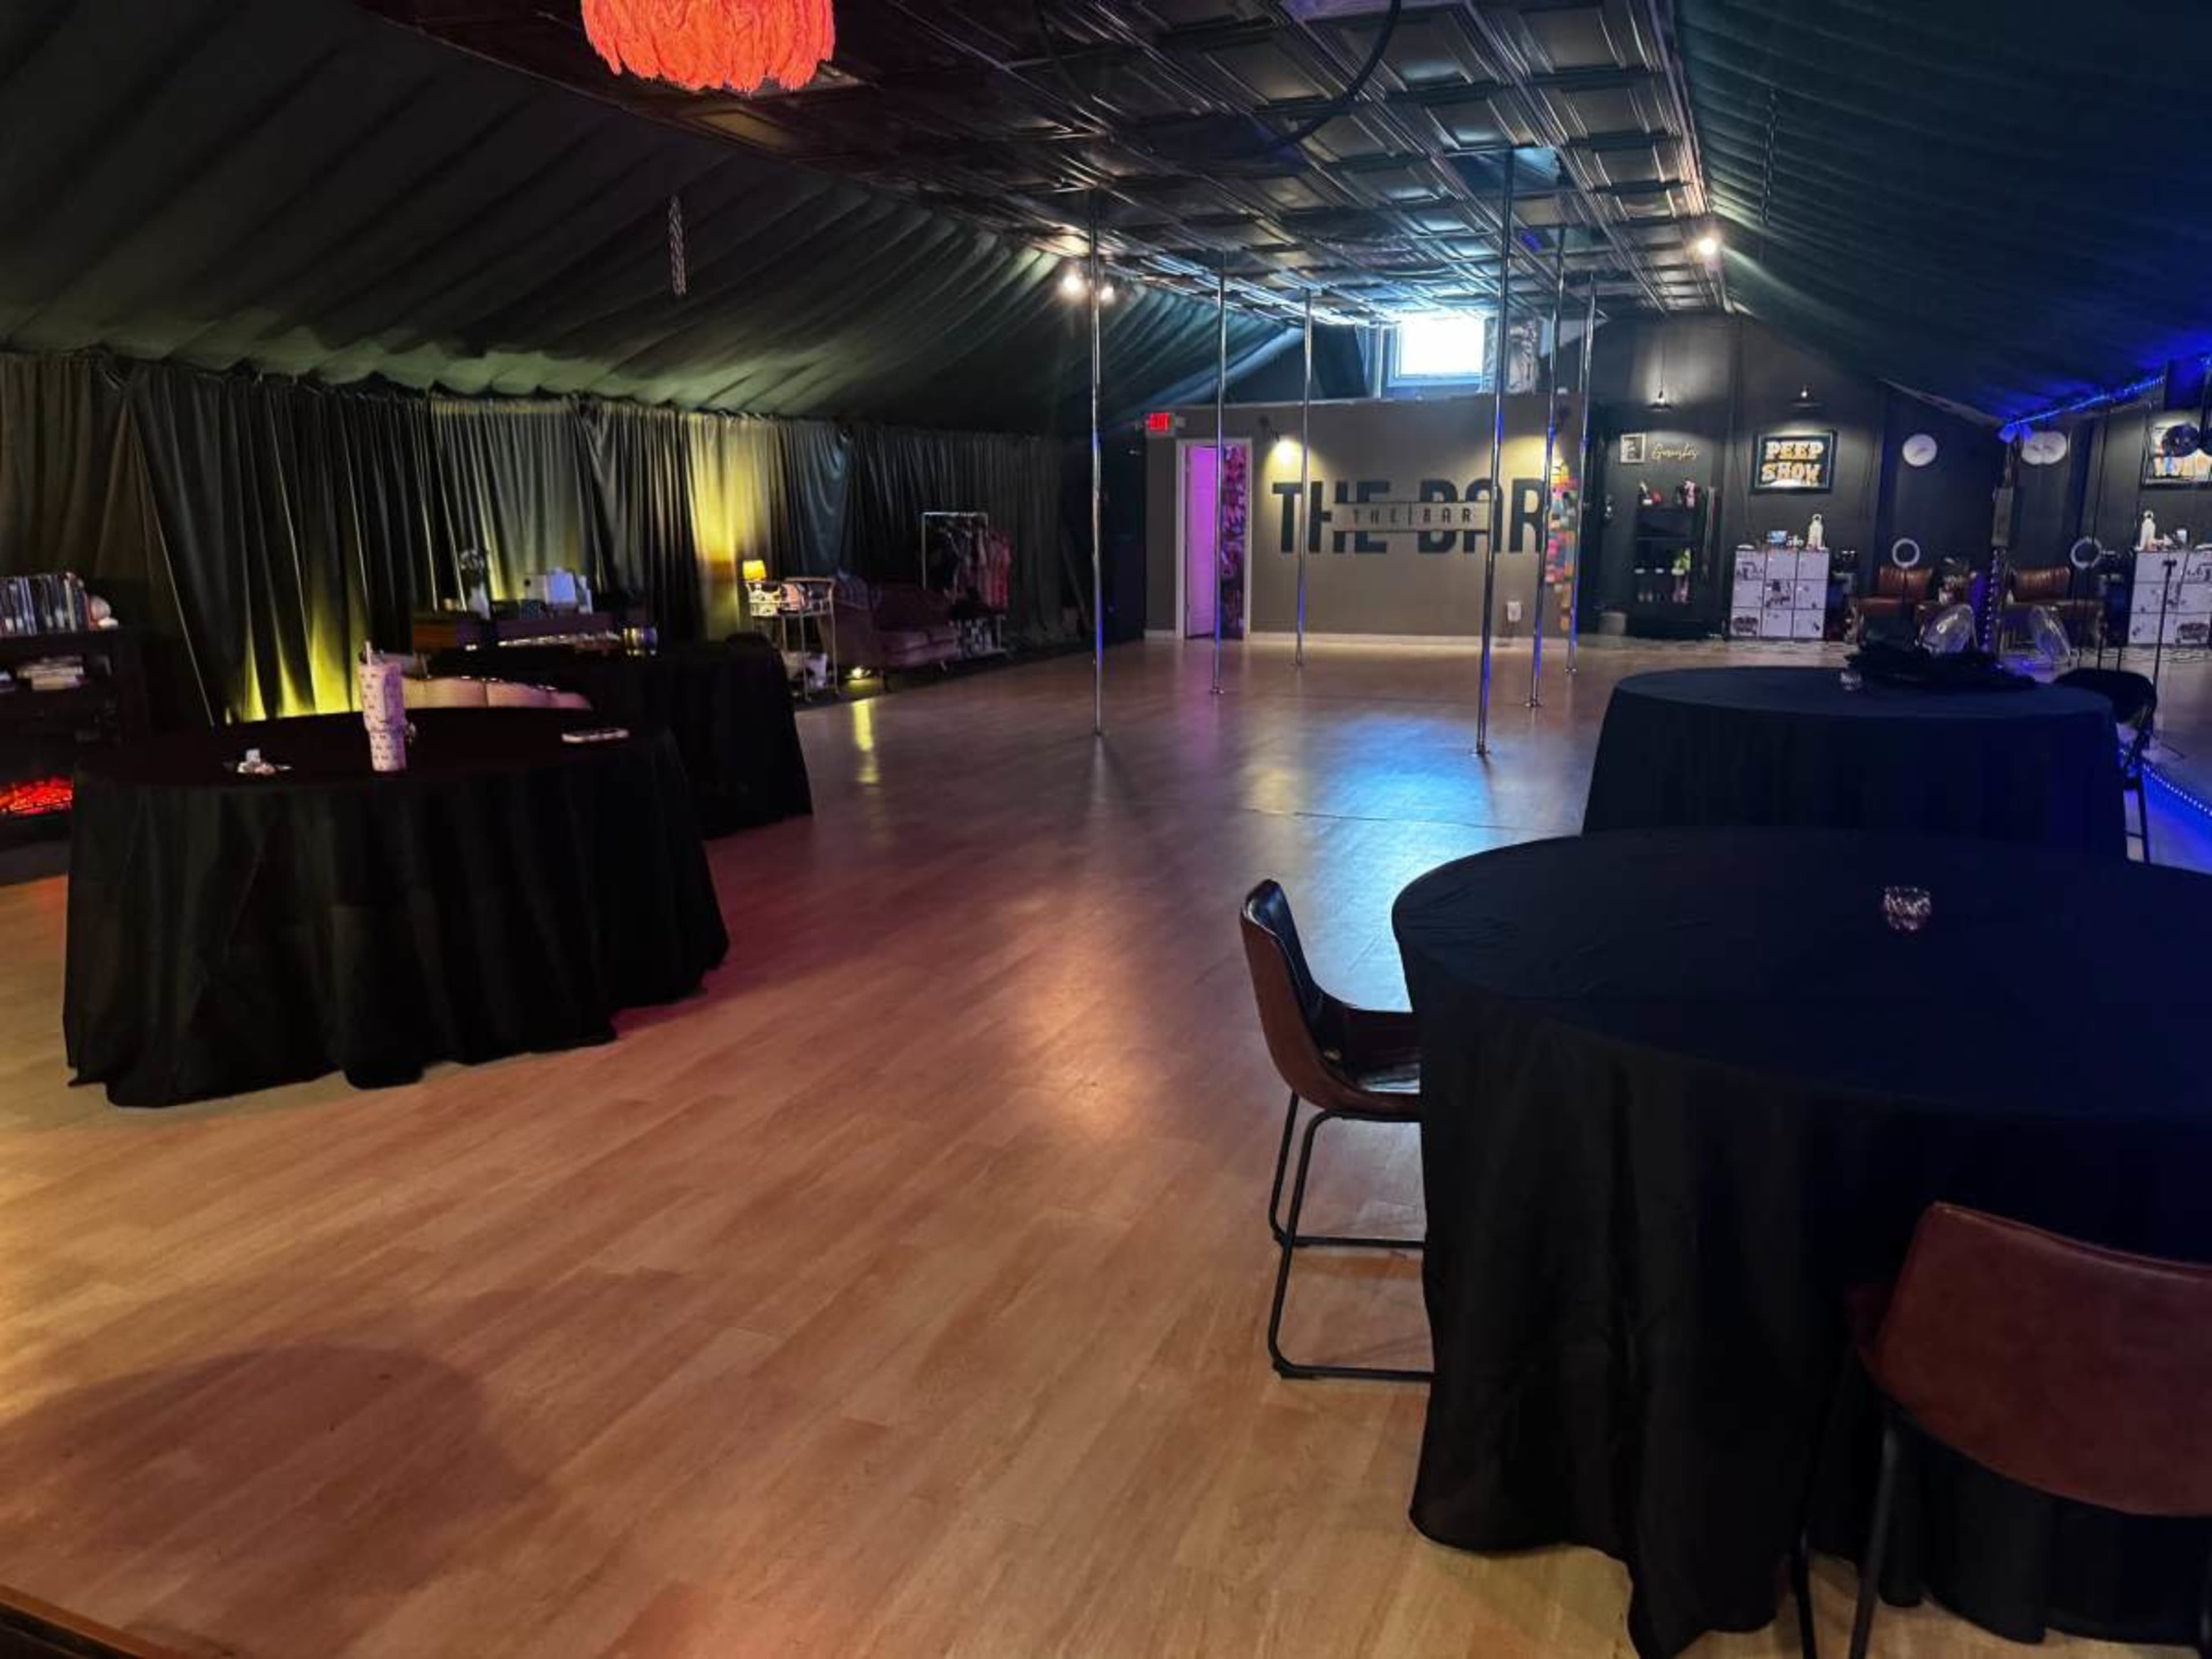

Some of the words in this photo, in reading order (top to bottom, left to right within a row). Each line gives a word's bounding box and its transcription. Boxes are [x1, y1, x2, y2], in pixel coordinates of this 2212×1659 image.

[1765, 441, 1824, 460] PEEP
[1762, 461, 1821, 486] SHOW
[1272, 480, 1390, 553] THE
[1418, 478, 1548, 553] BAR
[1422, 507, 1471, 524] BAR
